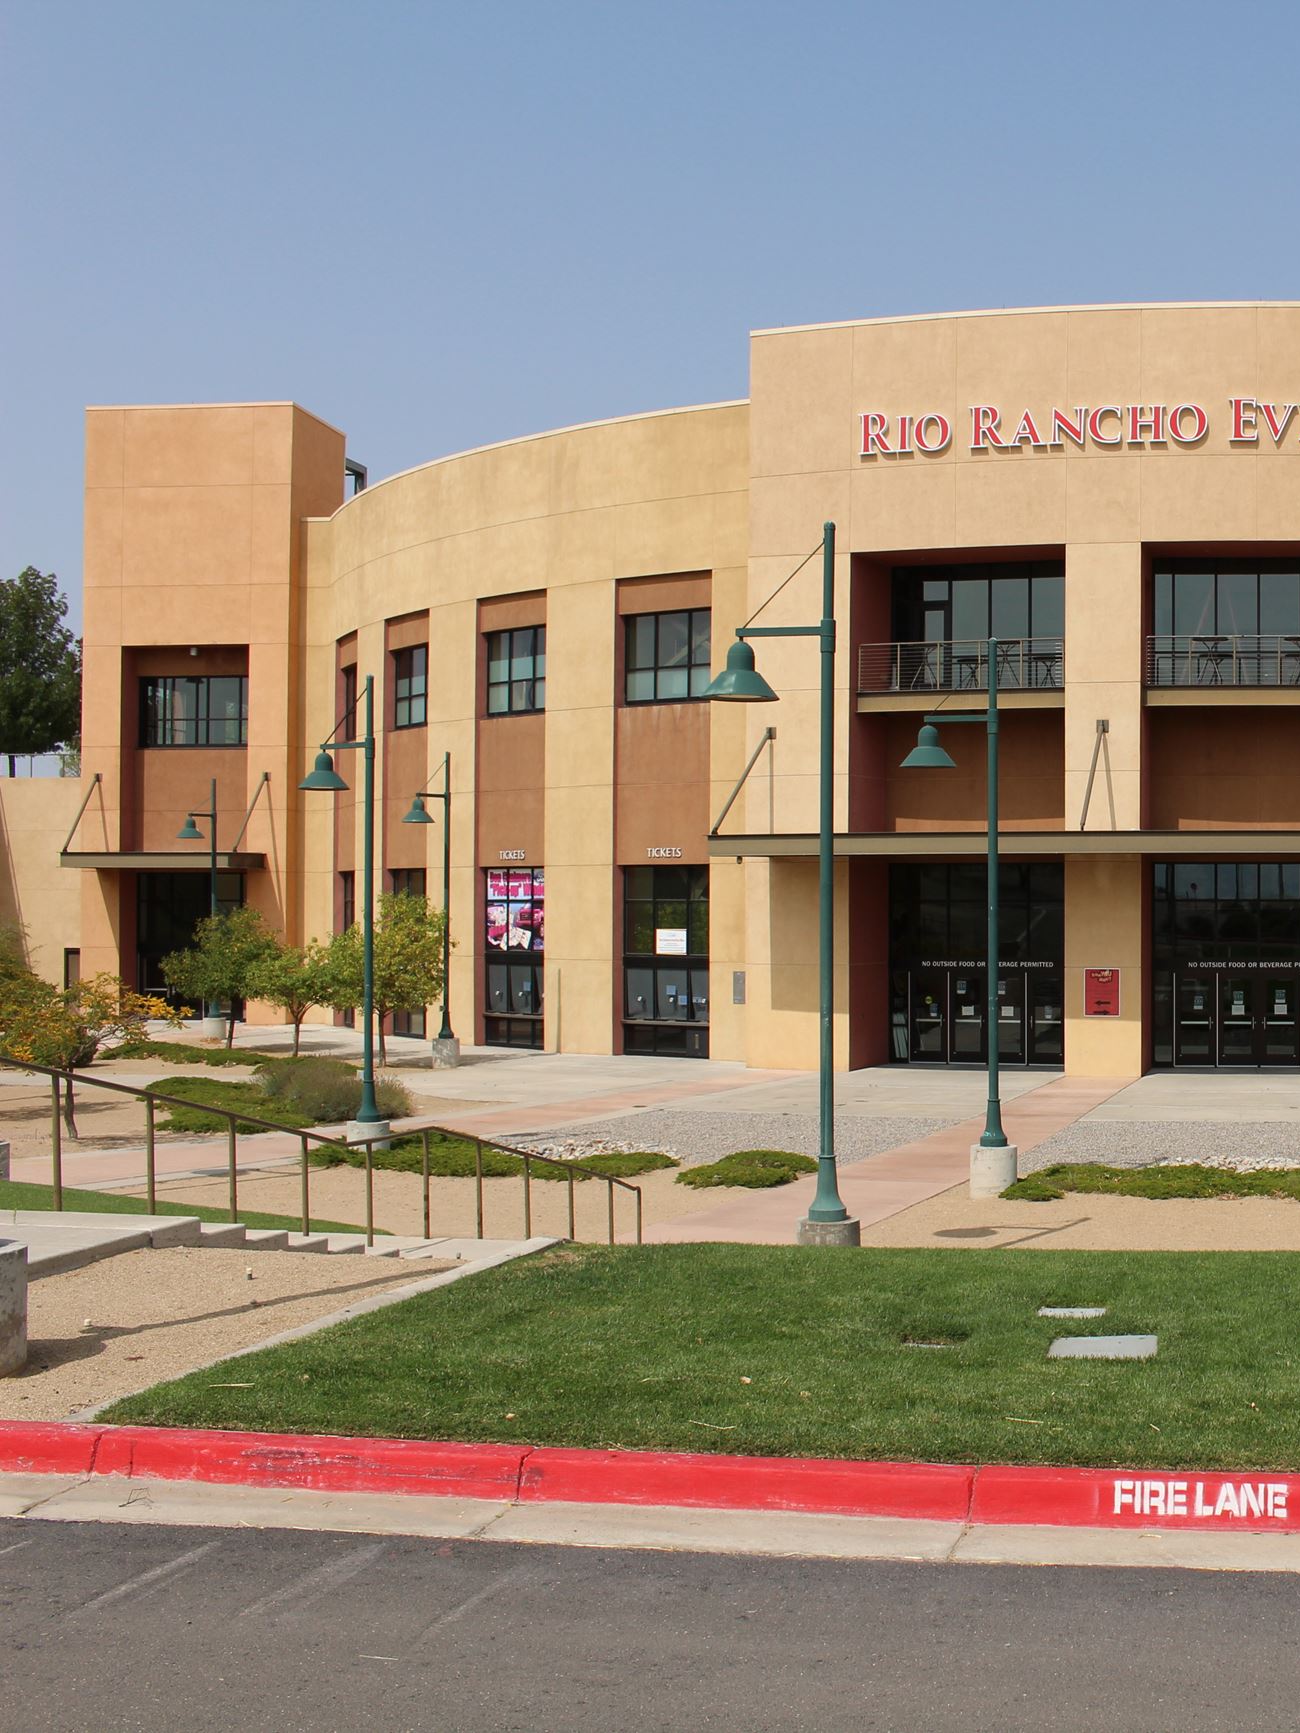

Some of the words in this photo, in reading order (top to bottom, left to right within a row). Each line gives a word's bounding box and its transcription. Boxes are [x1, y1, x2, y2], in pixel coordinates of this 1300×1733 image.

[858, 412, 951, 456] RIO
[968, 403, 1208, 449] RANCHO
[499, 850, 526, 860] TICKETS
[646, 847, 682, 858] TICKETS
[1113, 1480, 1188, 1516] FIRE
[1194, 1481, 1288, 1518] LANE
